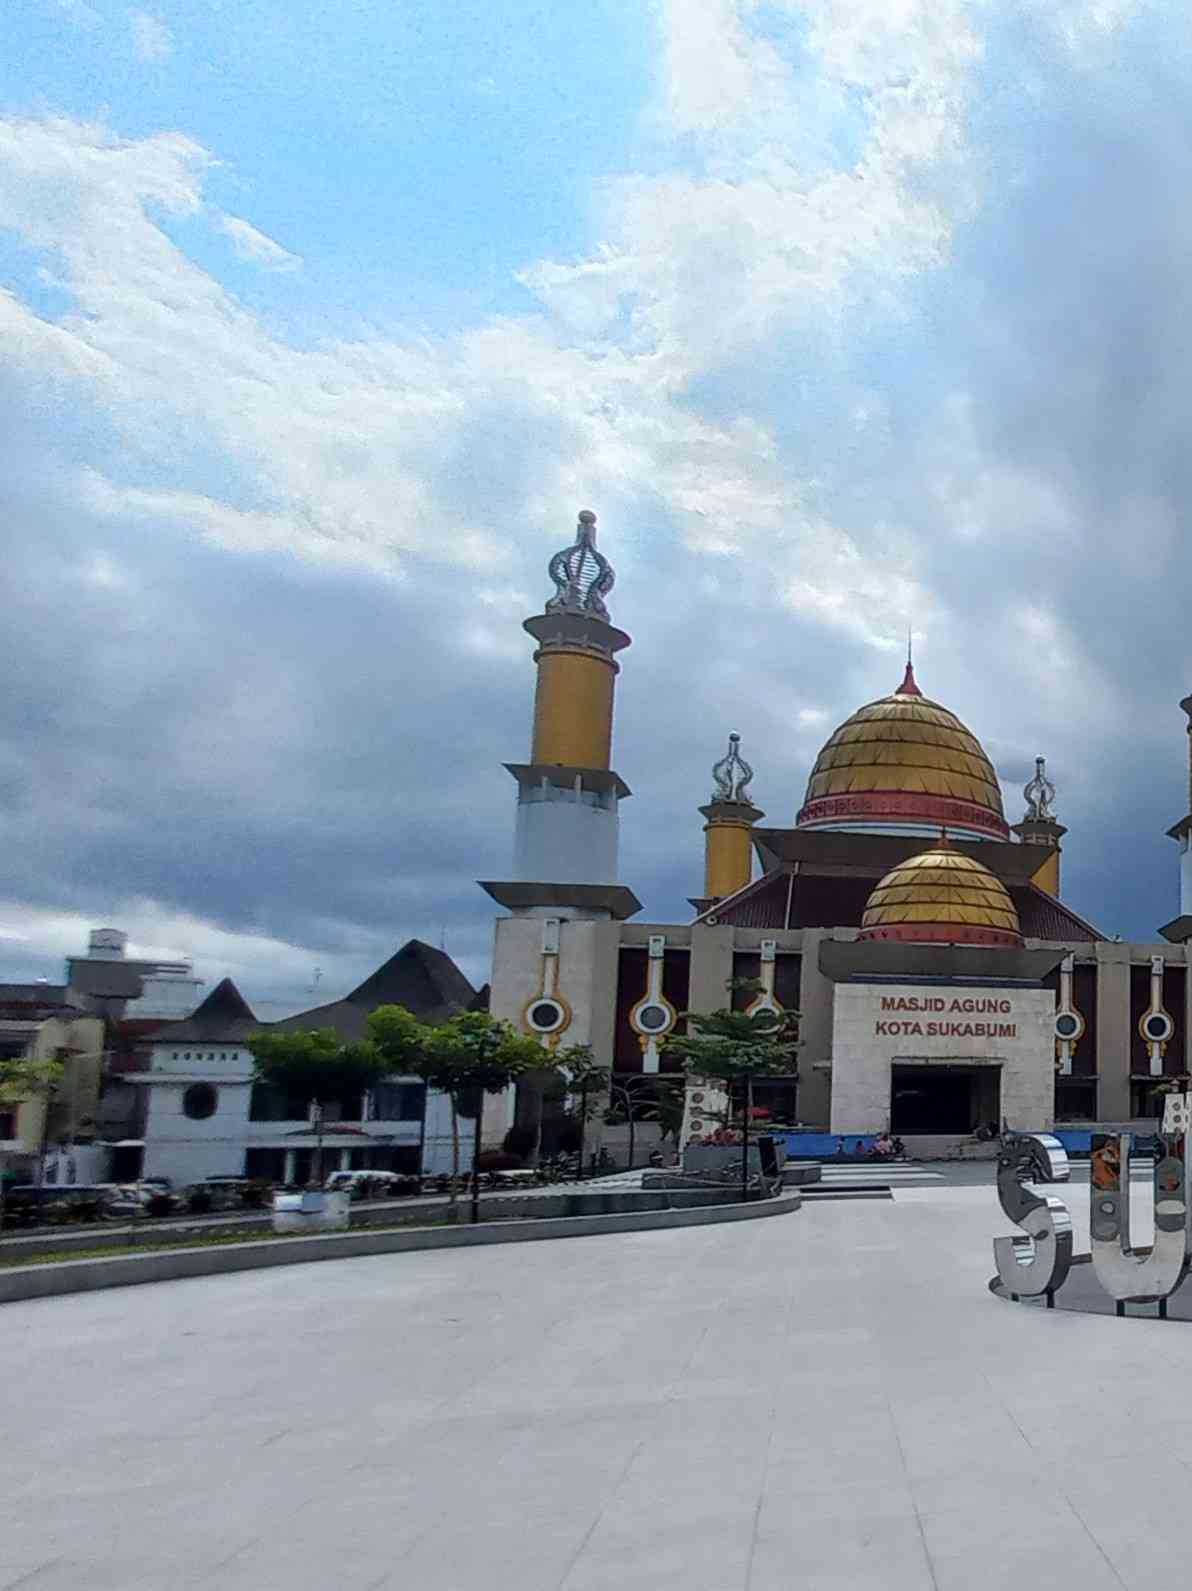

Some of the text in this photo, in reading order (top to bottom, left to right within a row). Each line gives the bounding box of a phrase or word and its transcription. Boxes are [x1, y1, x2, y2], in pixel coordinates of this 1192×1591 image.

[881, 996, 1011, 1013] MASJID AGUNG
[875, 1021, 1016, 1037] KOTA SUKABUMI
